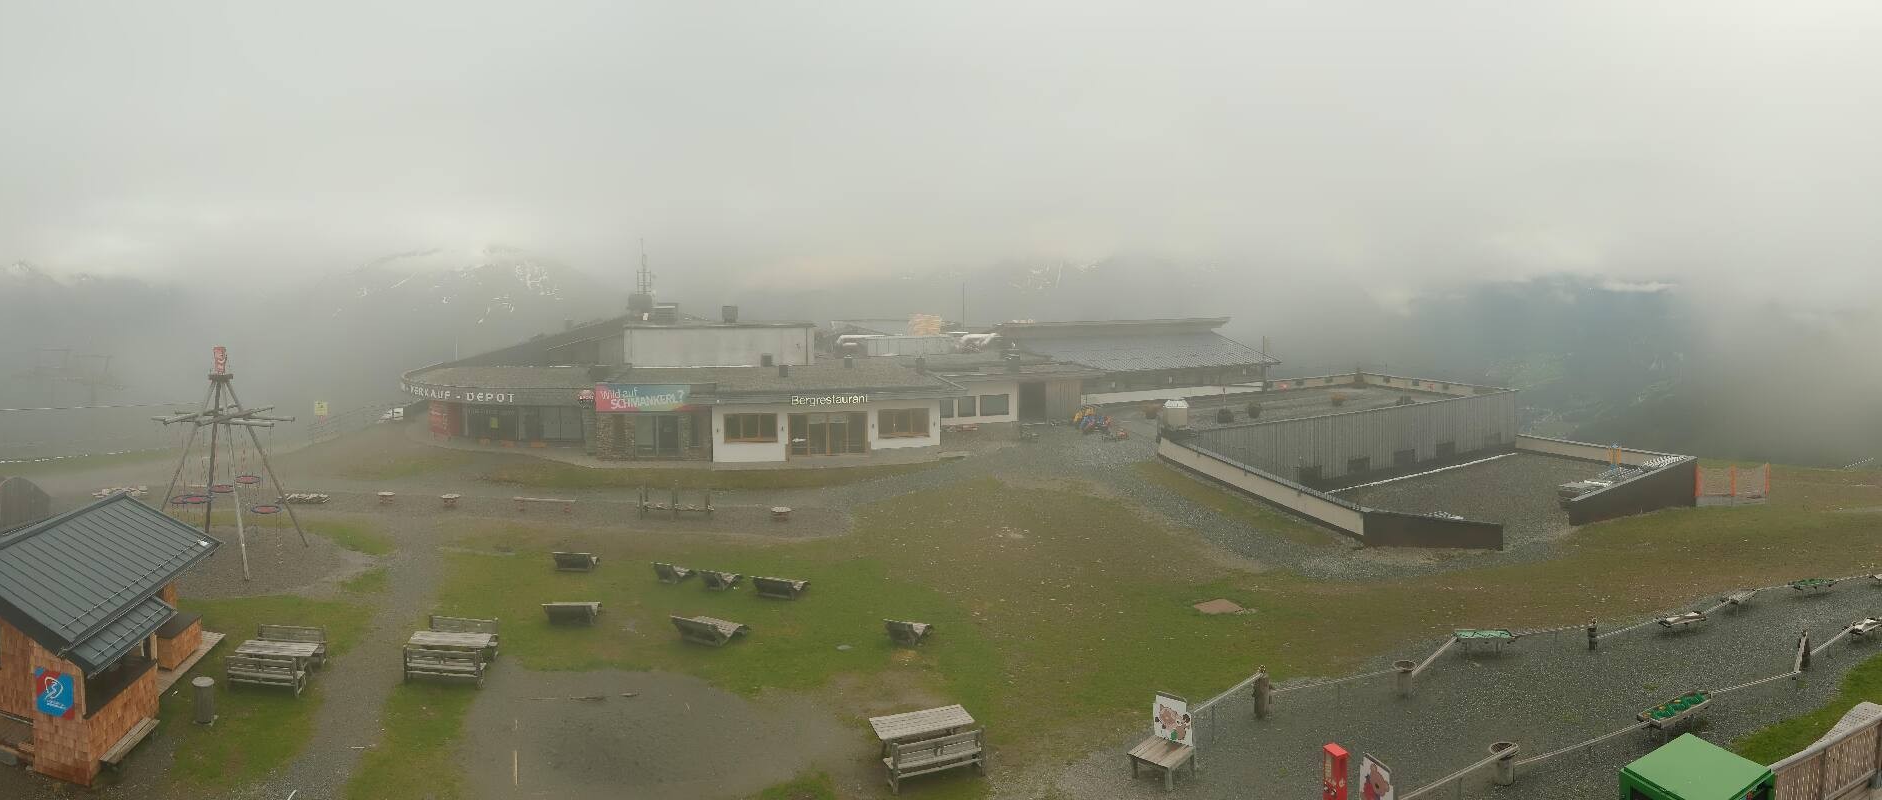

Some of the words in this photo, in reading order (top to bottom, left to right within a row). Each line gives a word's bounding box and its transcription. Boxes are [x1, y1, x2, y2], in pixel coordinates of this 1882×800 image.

[409, 385, 451, 400] VERKAUF
[466, 392, 515, 403] DEPOT
[600, 388, 621, 400] Wild
[622, 386, 639, 399] auf
[610, 390, 685, 410] SCHMANKERL?
[791, 394, 868, 406] Bergrestaurant
